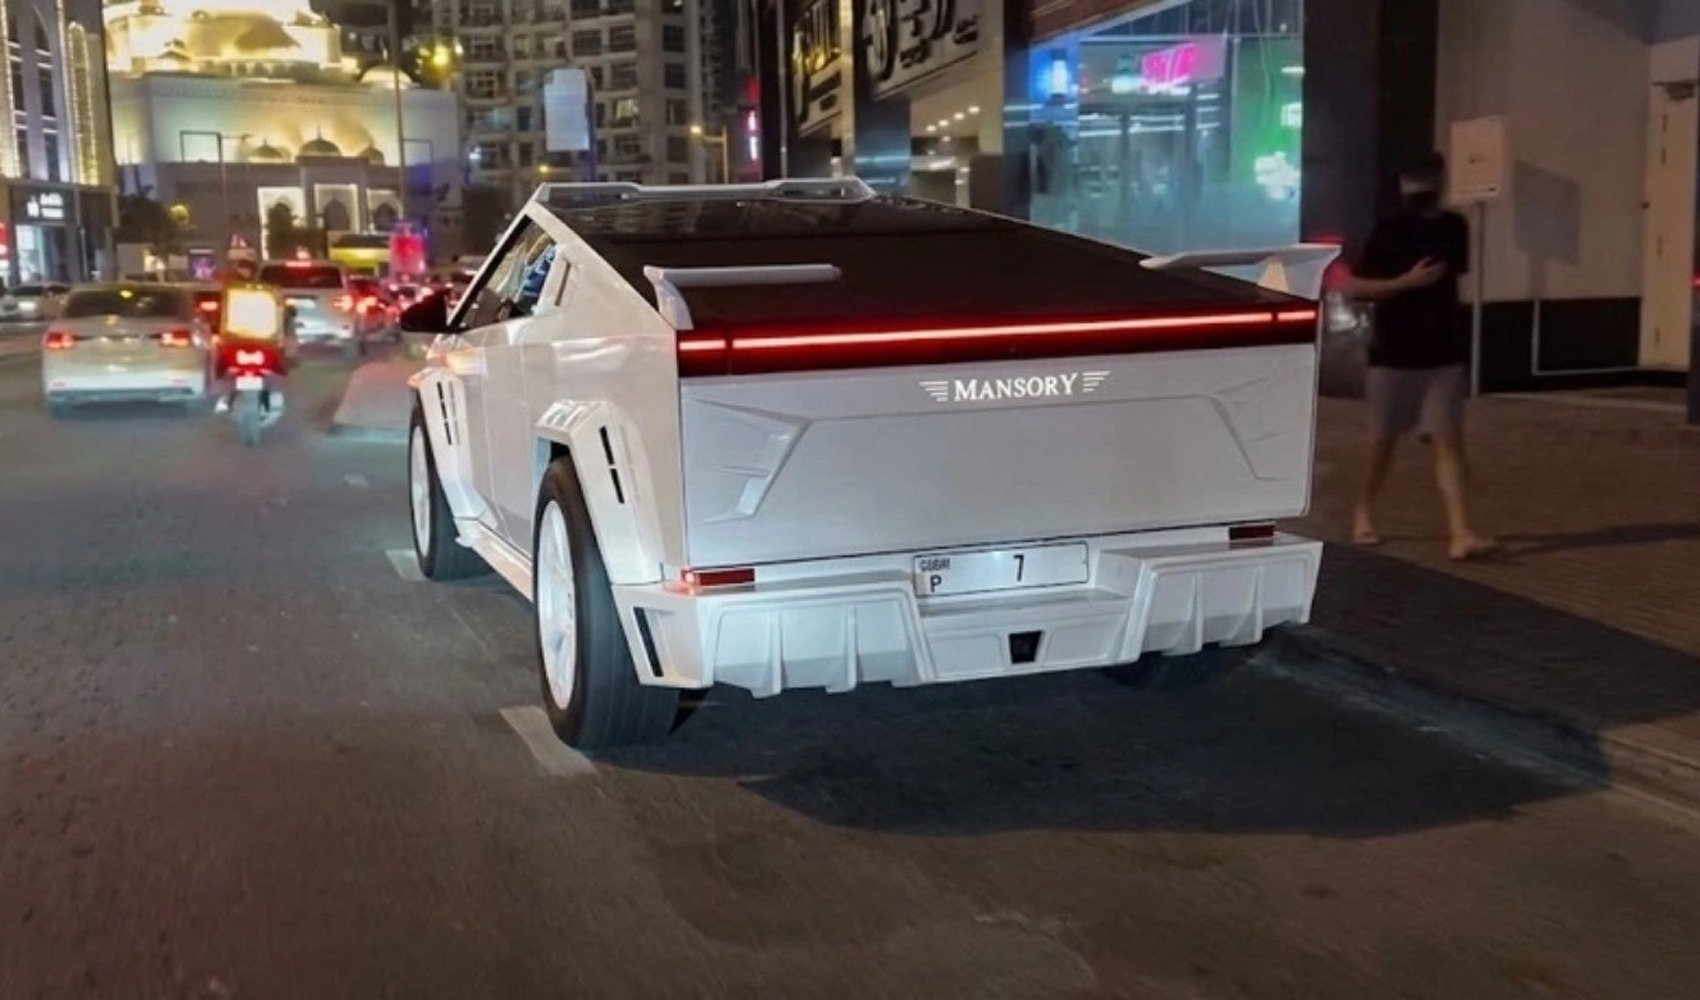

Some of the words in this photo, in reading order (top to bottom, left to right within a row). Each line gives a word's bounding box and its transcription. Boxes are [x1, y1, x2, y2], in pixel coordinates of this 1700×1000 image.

[954, 372, 1078, 402] MANSORY
[1012, 554, 1024, 582] 7
[930, 574, 942, 593] P
